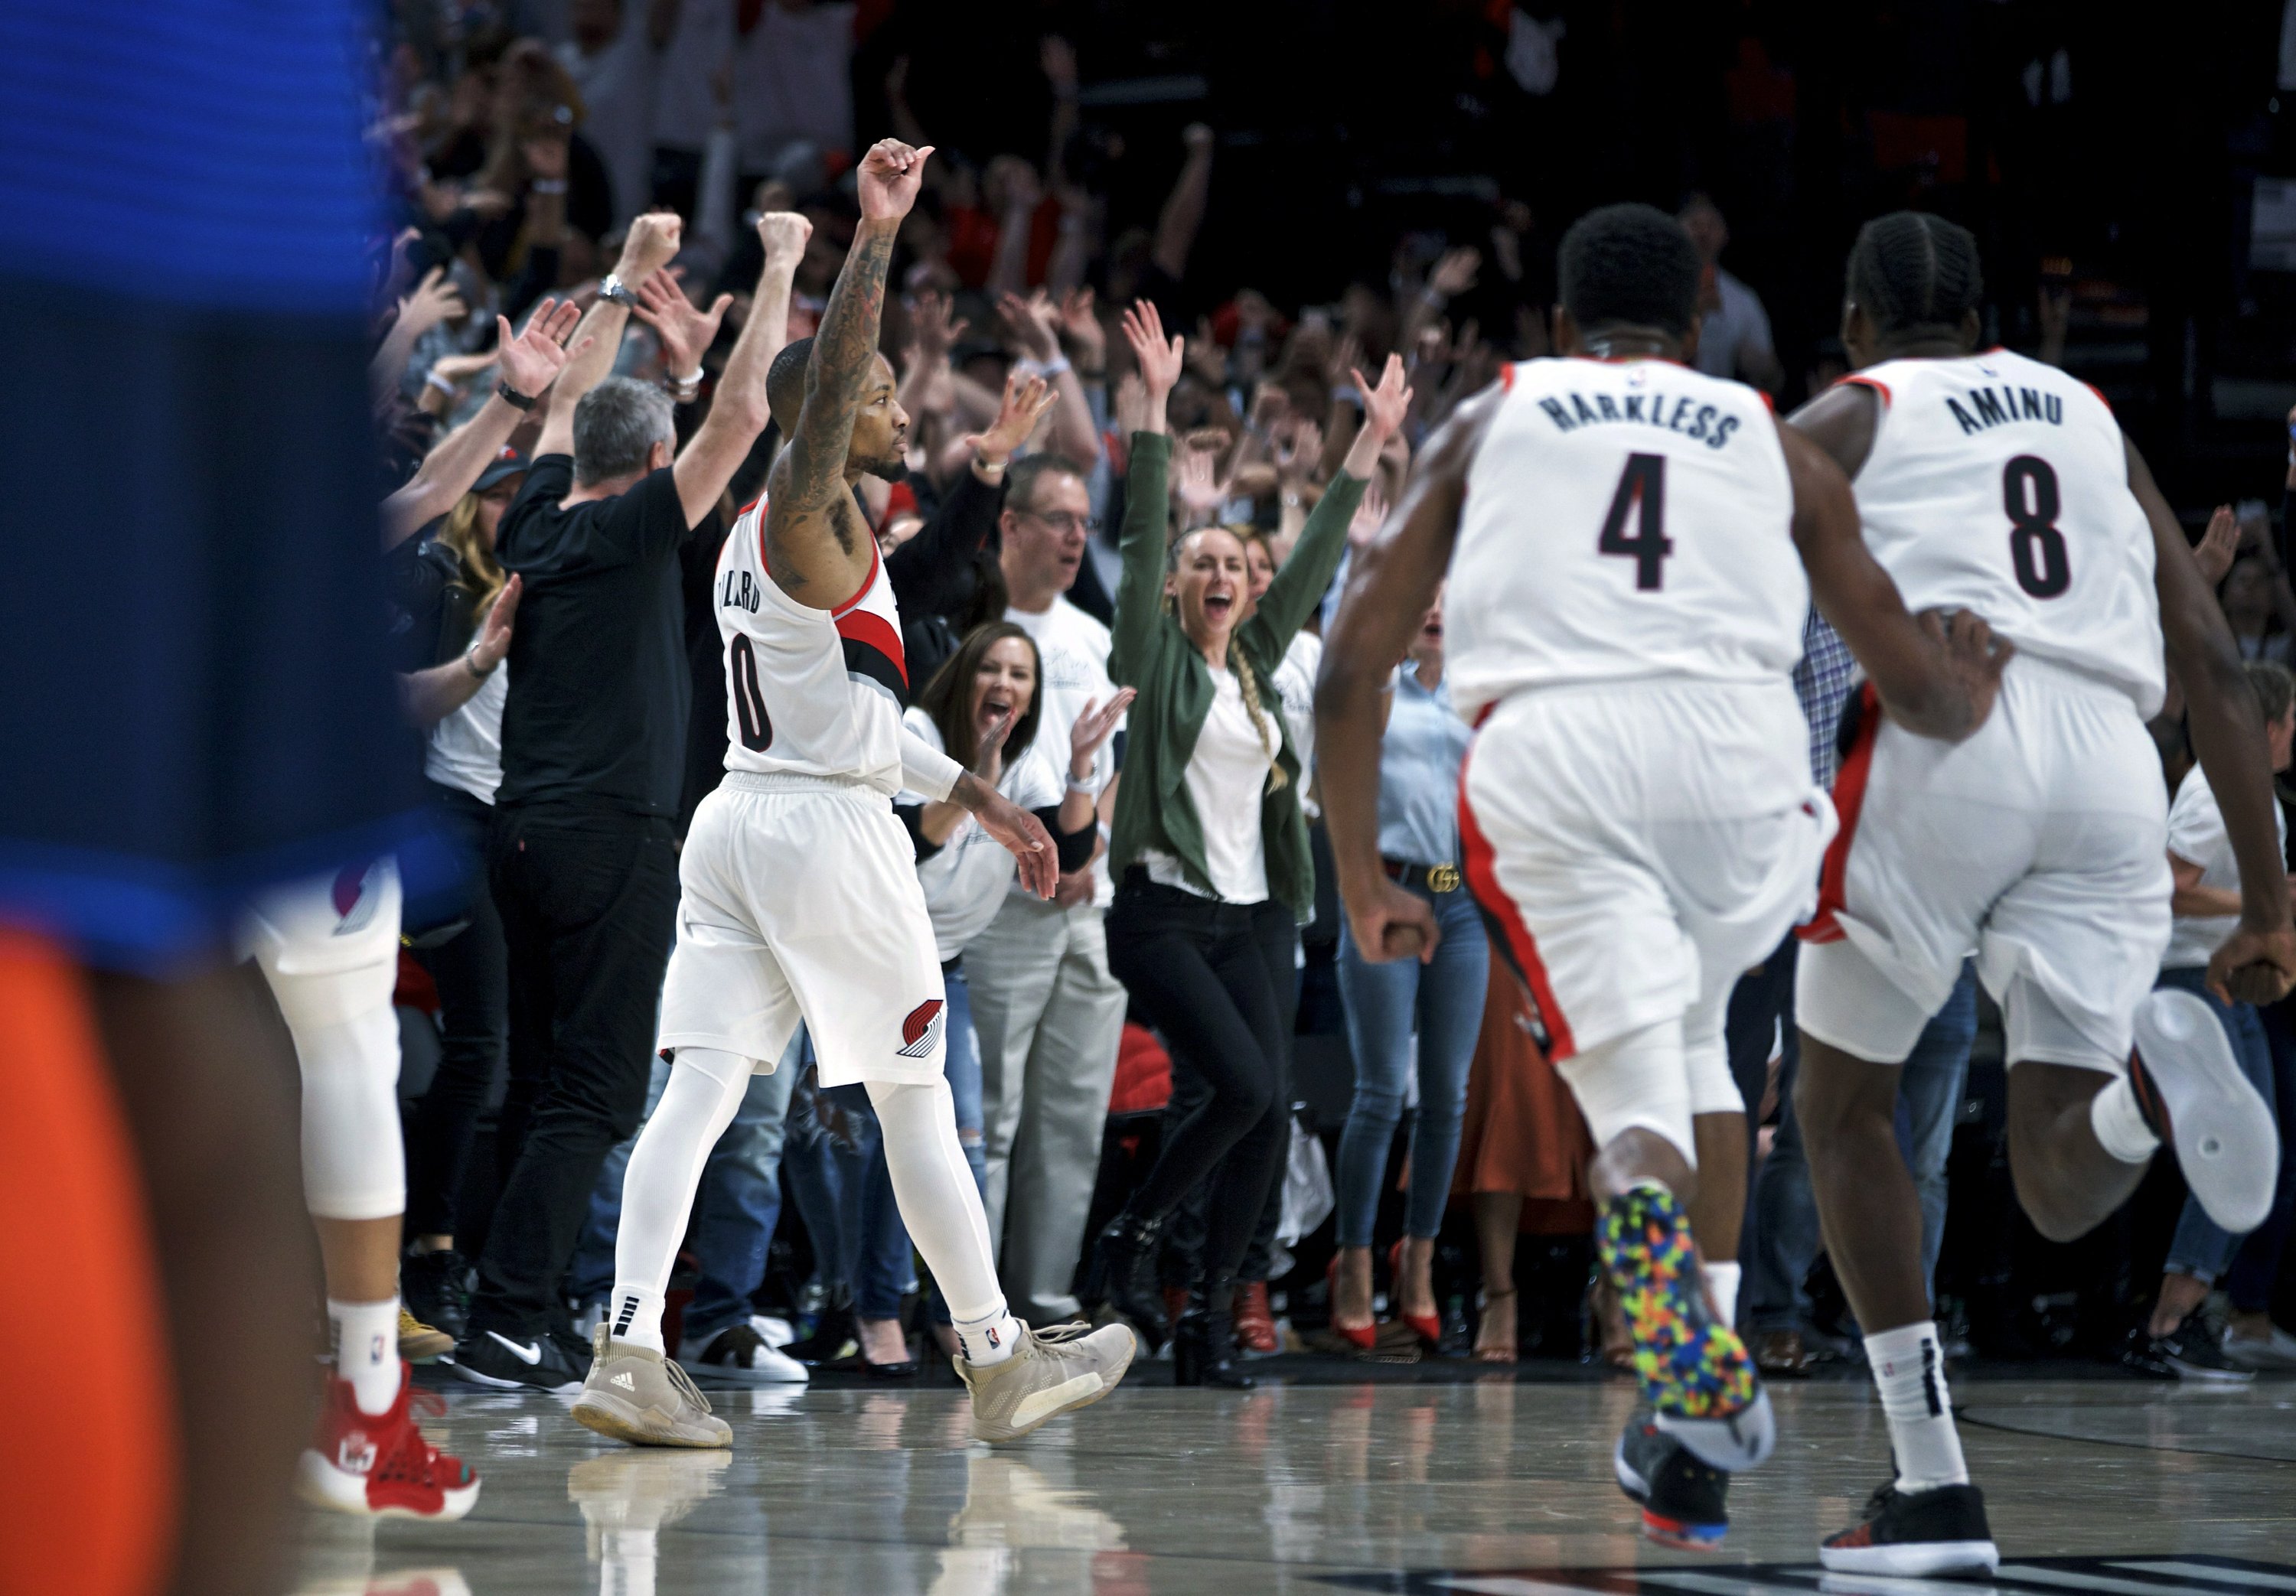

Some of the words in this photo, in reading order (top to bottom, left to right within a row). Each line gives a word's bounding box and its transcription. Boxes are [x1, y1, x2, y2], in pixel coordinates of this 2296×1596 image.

[1538, 393, 1741, 448] HARKLESS
[1945, 386, 2063, 436] AMINU
[1599, 451, 1674, 591] 4
[2003, 454, 2071, 599] 8
[731, 632, 773, 752] 0
